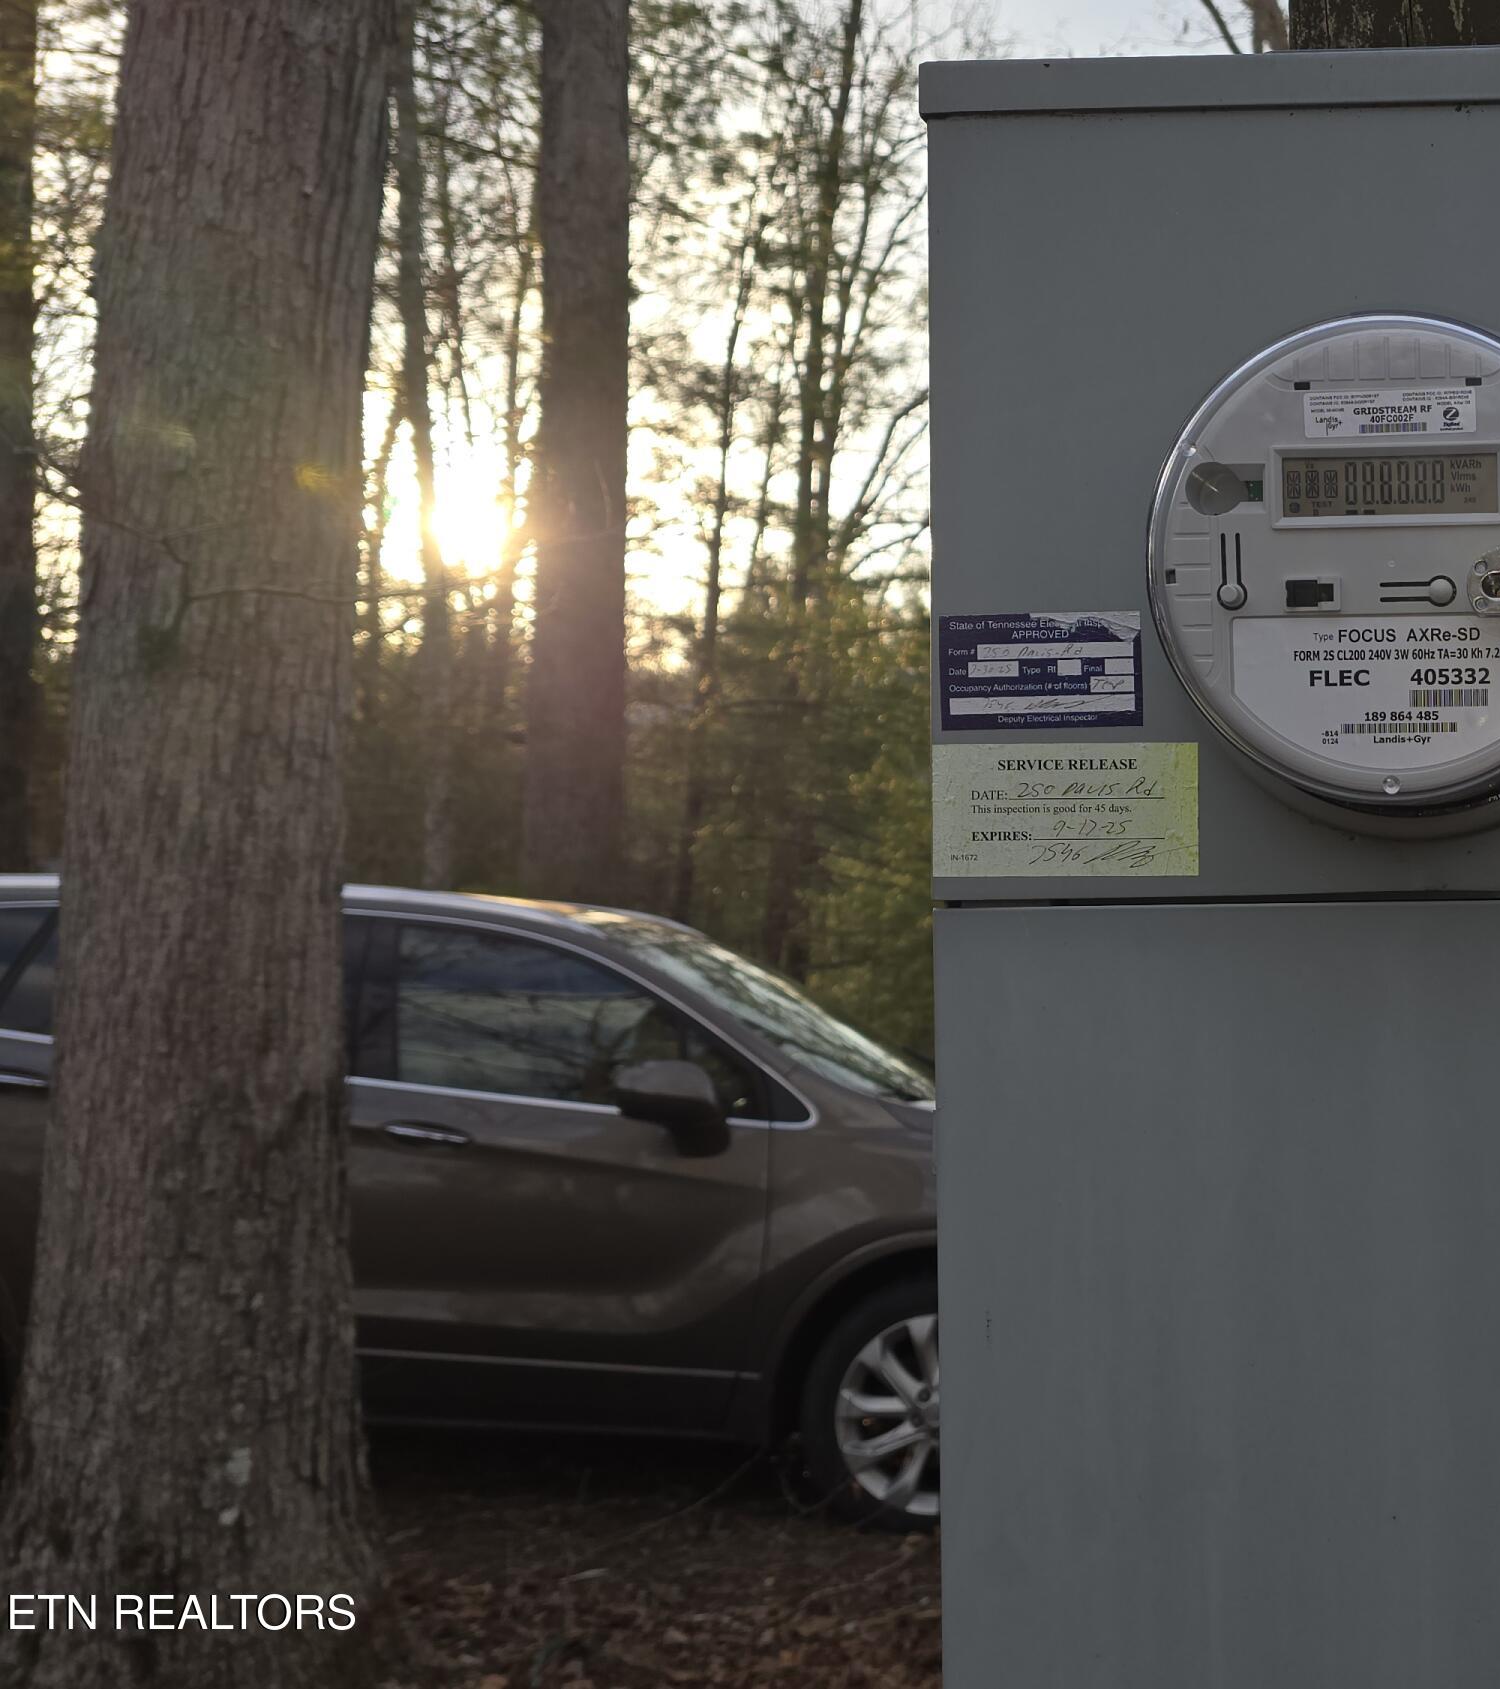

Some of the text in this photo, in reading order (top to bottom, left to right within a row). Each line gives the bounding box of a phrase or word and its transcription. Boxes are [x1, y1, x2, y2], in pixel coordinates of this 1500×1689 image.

[1353, 405, 1417, 415] GRIDSTREAM
[1420, 405, 1433, 413] RF
[1370, 414, 1414, 423] 40FC002F
[1450, 459, 1482, 469] kVARh
[1450, 483, 1471, 493] kWh
[949, 621, 974, 630] State
[975, 621, 985, 630] of
[988, 620, 1037, 629] Tennessee
[1011, 630, 1069, 639] APPROVED
[1313, 627, 1480, 643] Type FOCUS AXRe-SD
[948, 648, 968, 656] Form
[1294, 648, 1500, 661] FORM 2S CL200 240V 3W 60Hz TA=30 Kh 7.2
[949, 668, 966, 676] Date
[1022, 666, 1040, 675] Type
[1084, 664, 1102, 672] Final
[1309, 667, 1490, 687] FLEC 405332
[949, 684, 992, 694] Occupancy
[993, 682, 1042, 691] Authorization
[1063, 682, 1088, 690] floors)
[998, 714, 1098, 724] Deputy Electrical Inspector
[1364, 710, 1439, 722] 189 864 485
[1373, 734, 1432, 745] Landis+Gyr
[997, 758, 1138, 772] SERVICE RELEASE
[1018, 782, 1056, 798] 250
[1126, 776, 1157, 796] Rd
[971, 790, 1008, 800] DATE:
[971, 804, 1132, 816] This inspection is good for 45 days.
[971, 831, 1032, 842] EXPIRES:
[950, 854, 978, 862] IN-1672
